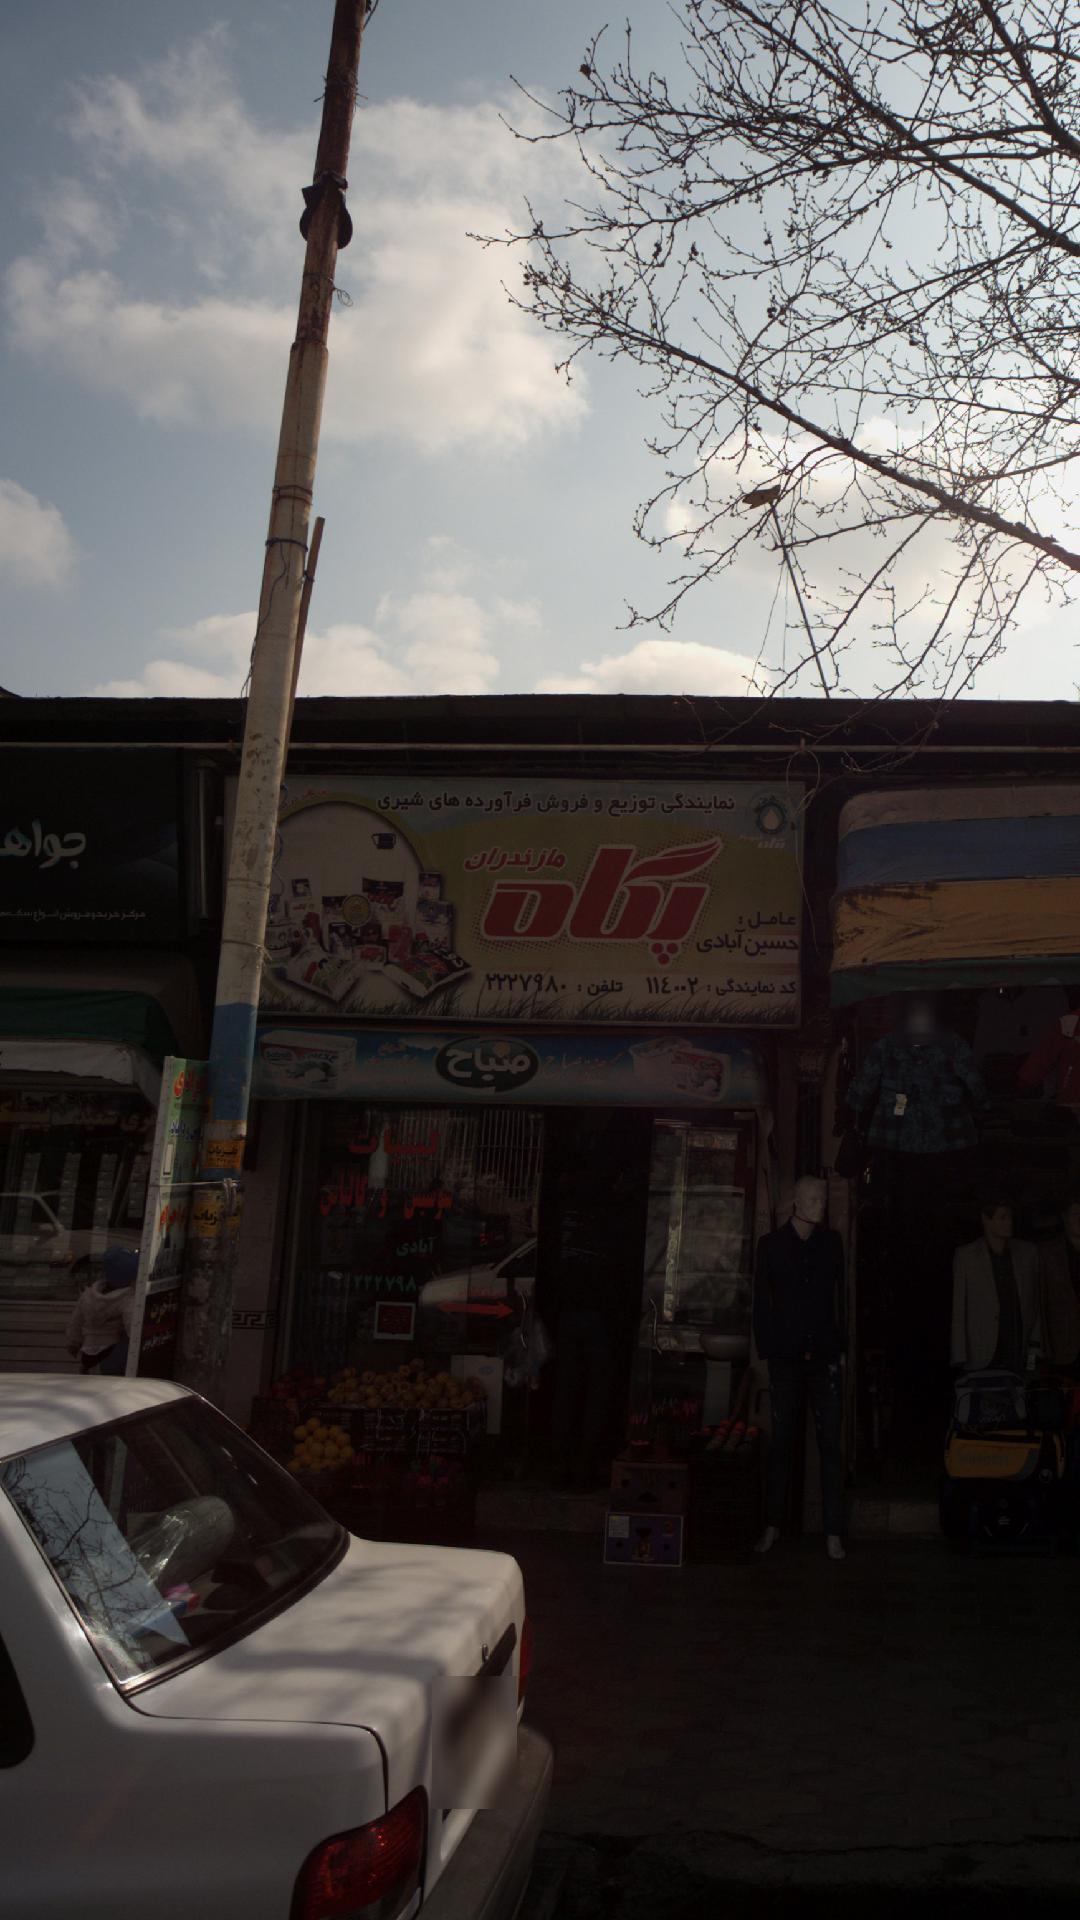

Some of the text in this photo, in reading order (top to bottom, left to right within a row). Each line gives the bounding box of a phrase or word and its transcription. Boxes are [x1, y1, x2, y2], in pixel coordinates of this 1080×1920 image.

[377, 790, 735, 817] نمایندگی توزیع و فروش فرآورده های شیری
[463, 846, 567, 873] مازندران
[482, 837, 723, 969] پگاه
[696, 929, 798, 957] حسین آبادی
[779, 979, 797, 994] کد
[445, 1045, 532, 1082] صباح
